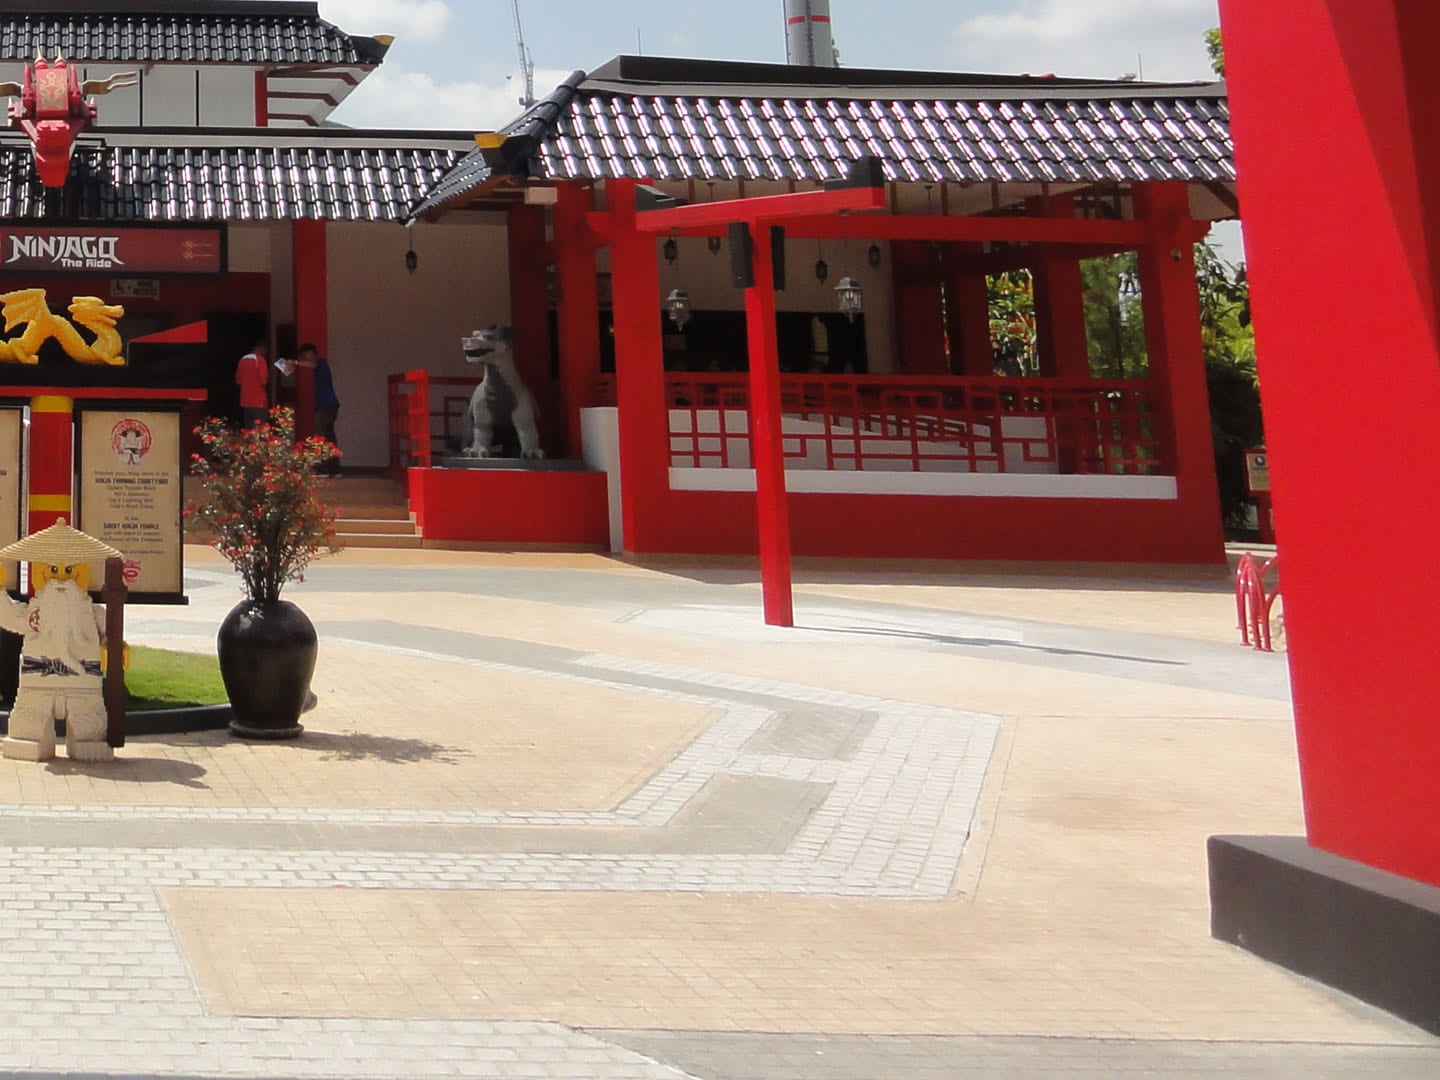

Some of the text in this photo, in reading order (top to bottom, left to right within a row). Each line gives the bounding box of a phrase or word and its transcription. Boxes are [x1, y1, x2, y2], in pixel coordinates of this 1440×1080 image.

[5, 235, 125, 265] NINJAGO
[61, 258, 112, 268] The Ride
